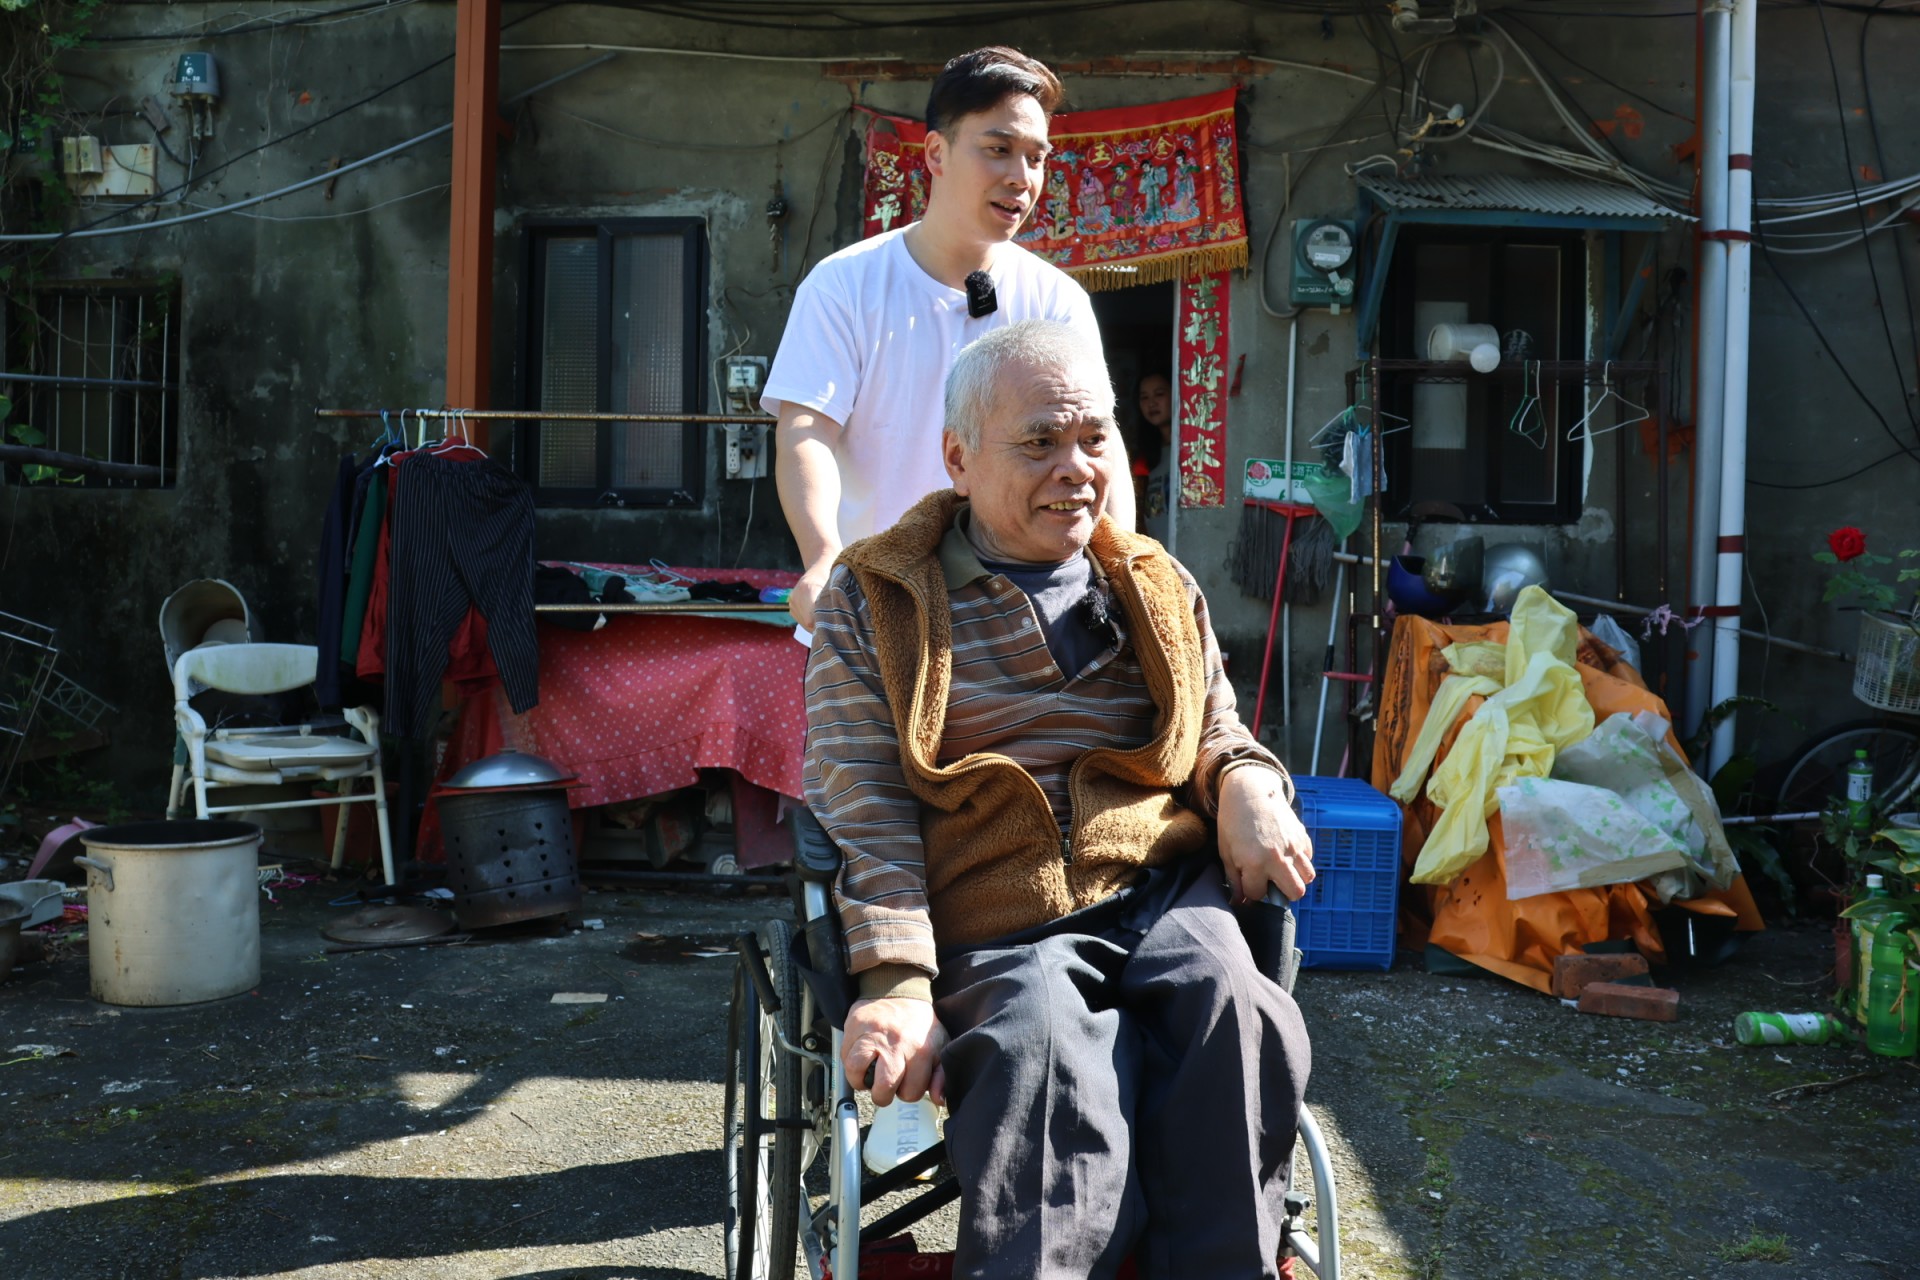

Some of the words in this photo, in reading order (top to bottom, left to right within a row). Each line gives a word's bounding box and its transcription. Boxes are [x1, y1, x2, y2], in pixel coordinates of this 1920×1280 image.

[1091, 144, 1111, 163] 玉
[1153, 136, 1174, 155] 金
[1181, 274, 1225, 473] 吉祥好運來
